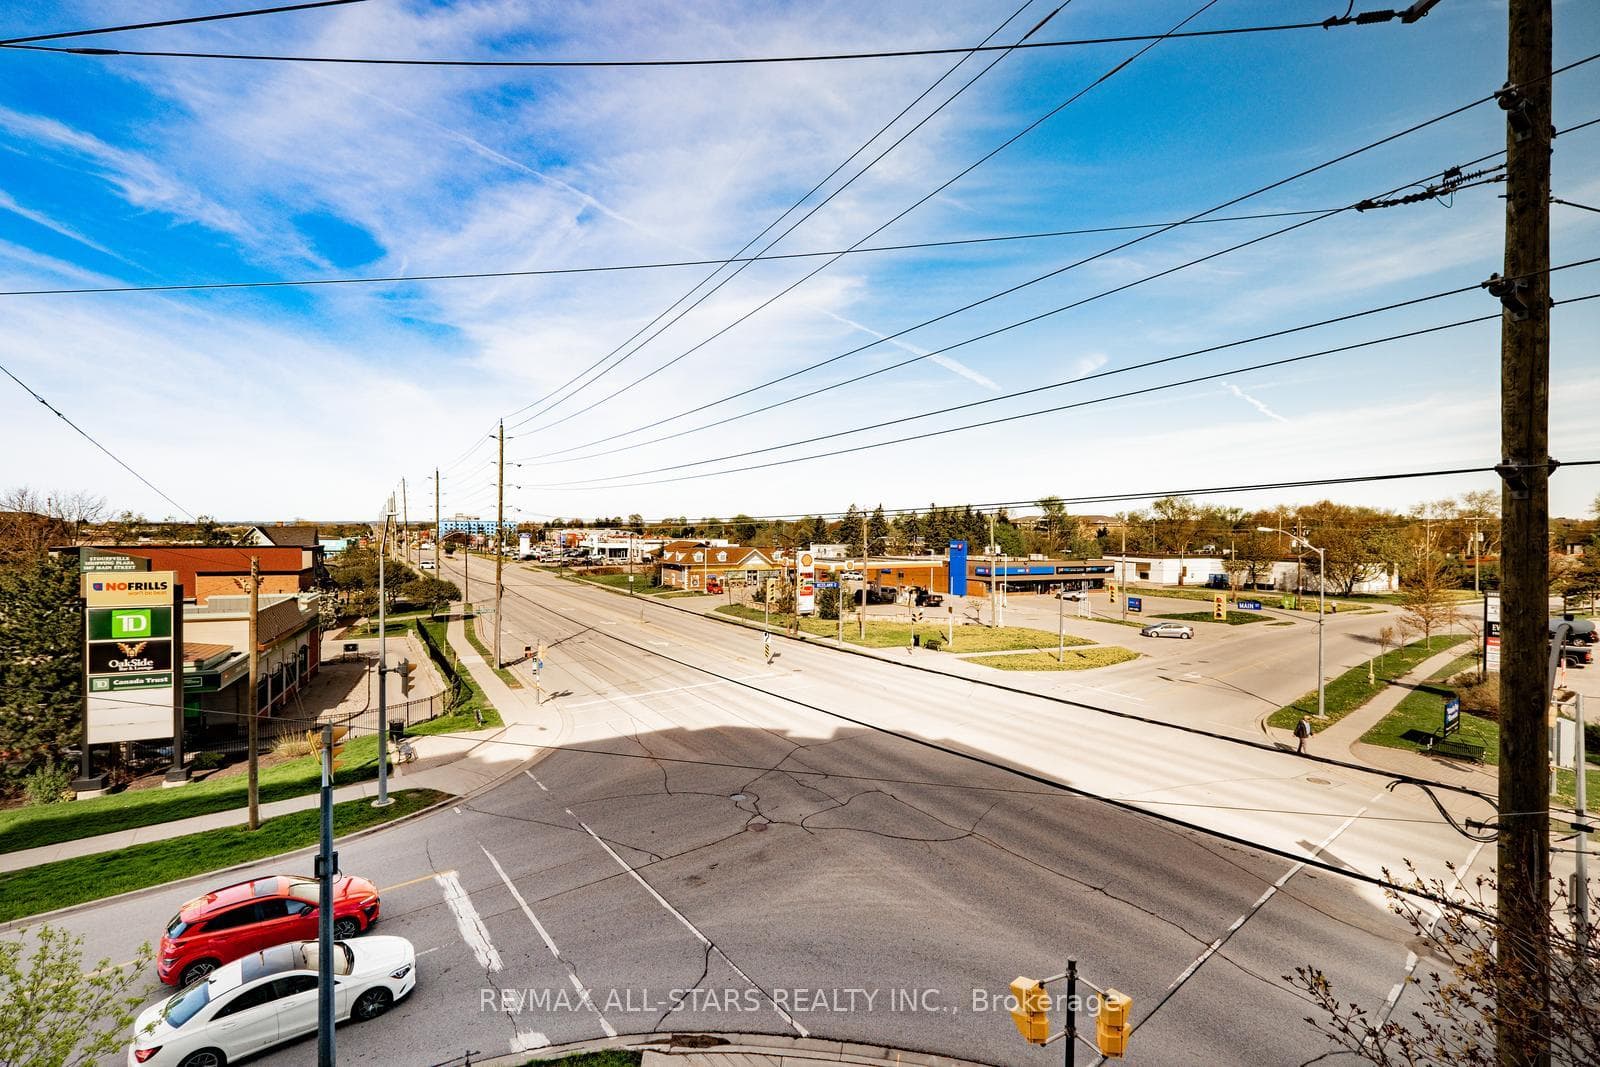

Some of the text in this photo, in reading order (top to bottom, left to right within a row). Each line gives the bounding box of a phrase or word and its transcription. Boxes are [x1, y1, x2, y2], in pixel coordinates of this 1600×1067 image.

[116, 615, 147, 632] TD
[108, 658, 154, 668] OakSide
[96, 680, 108, 688] TD
